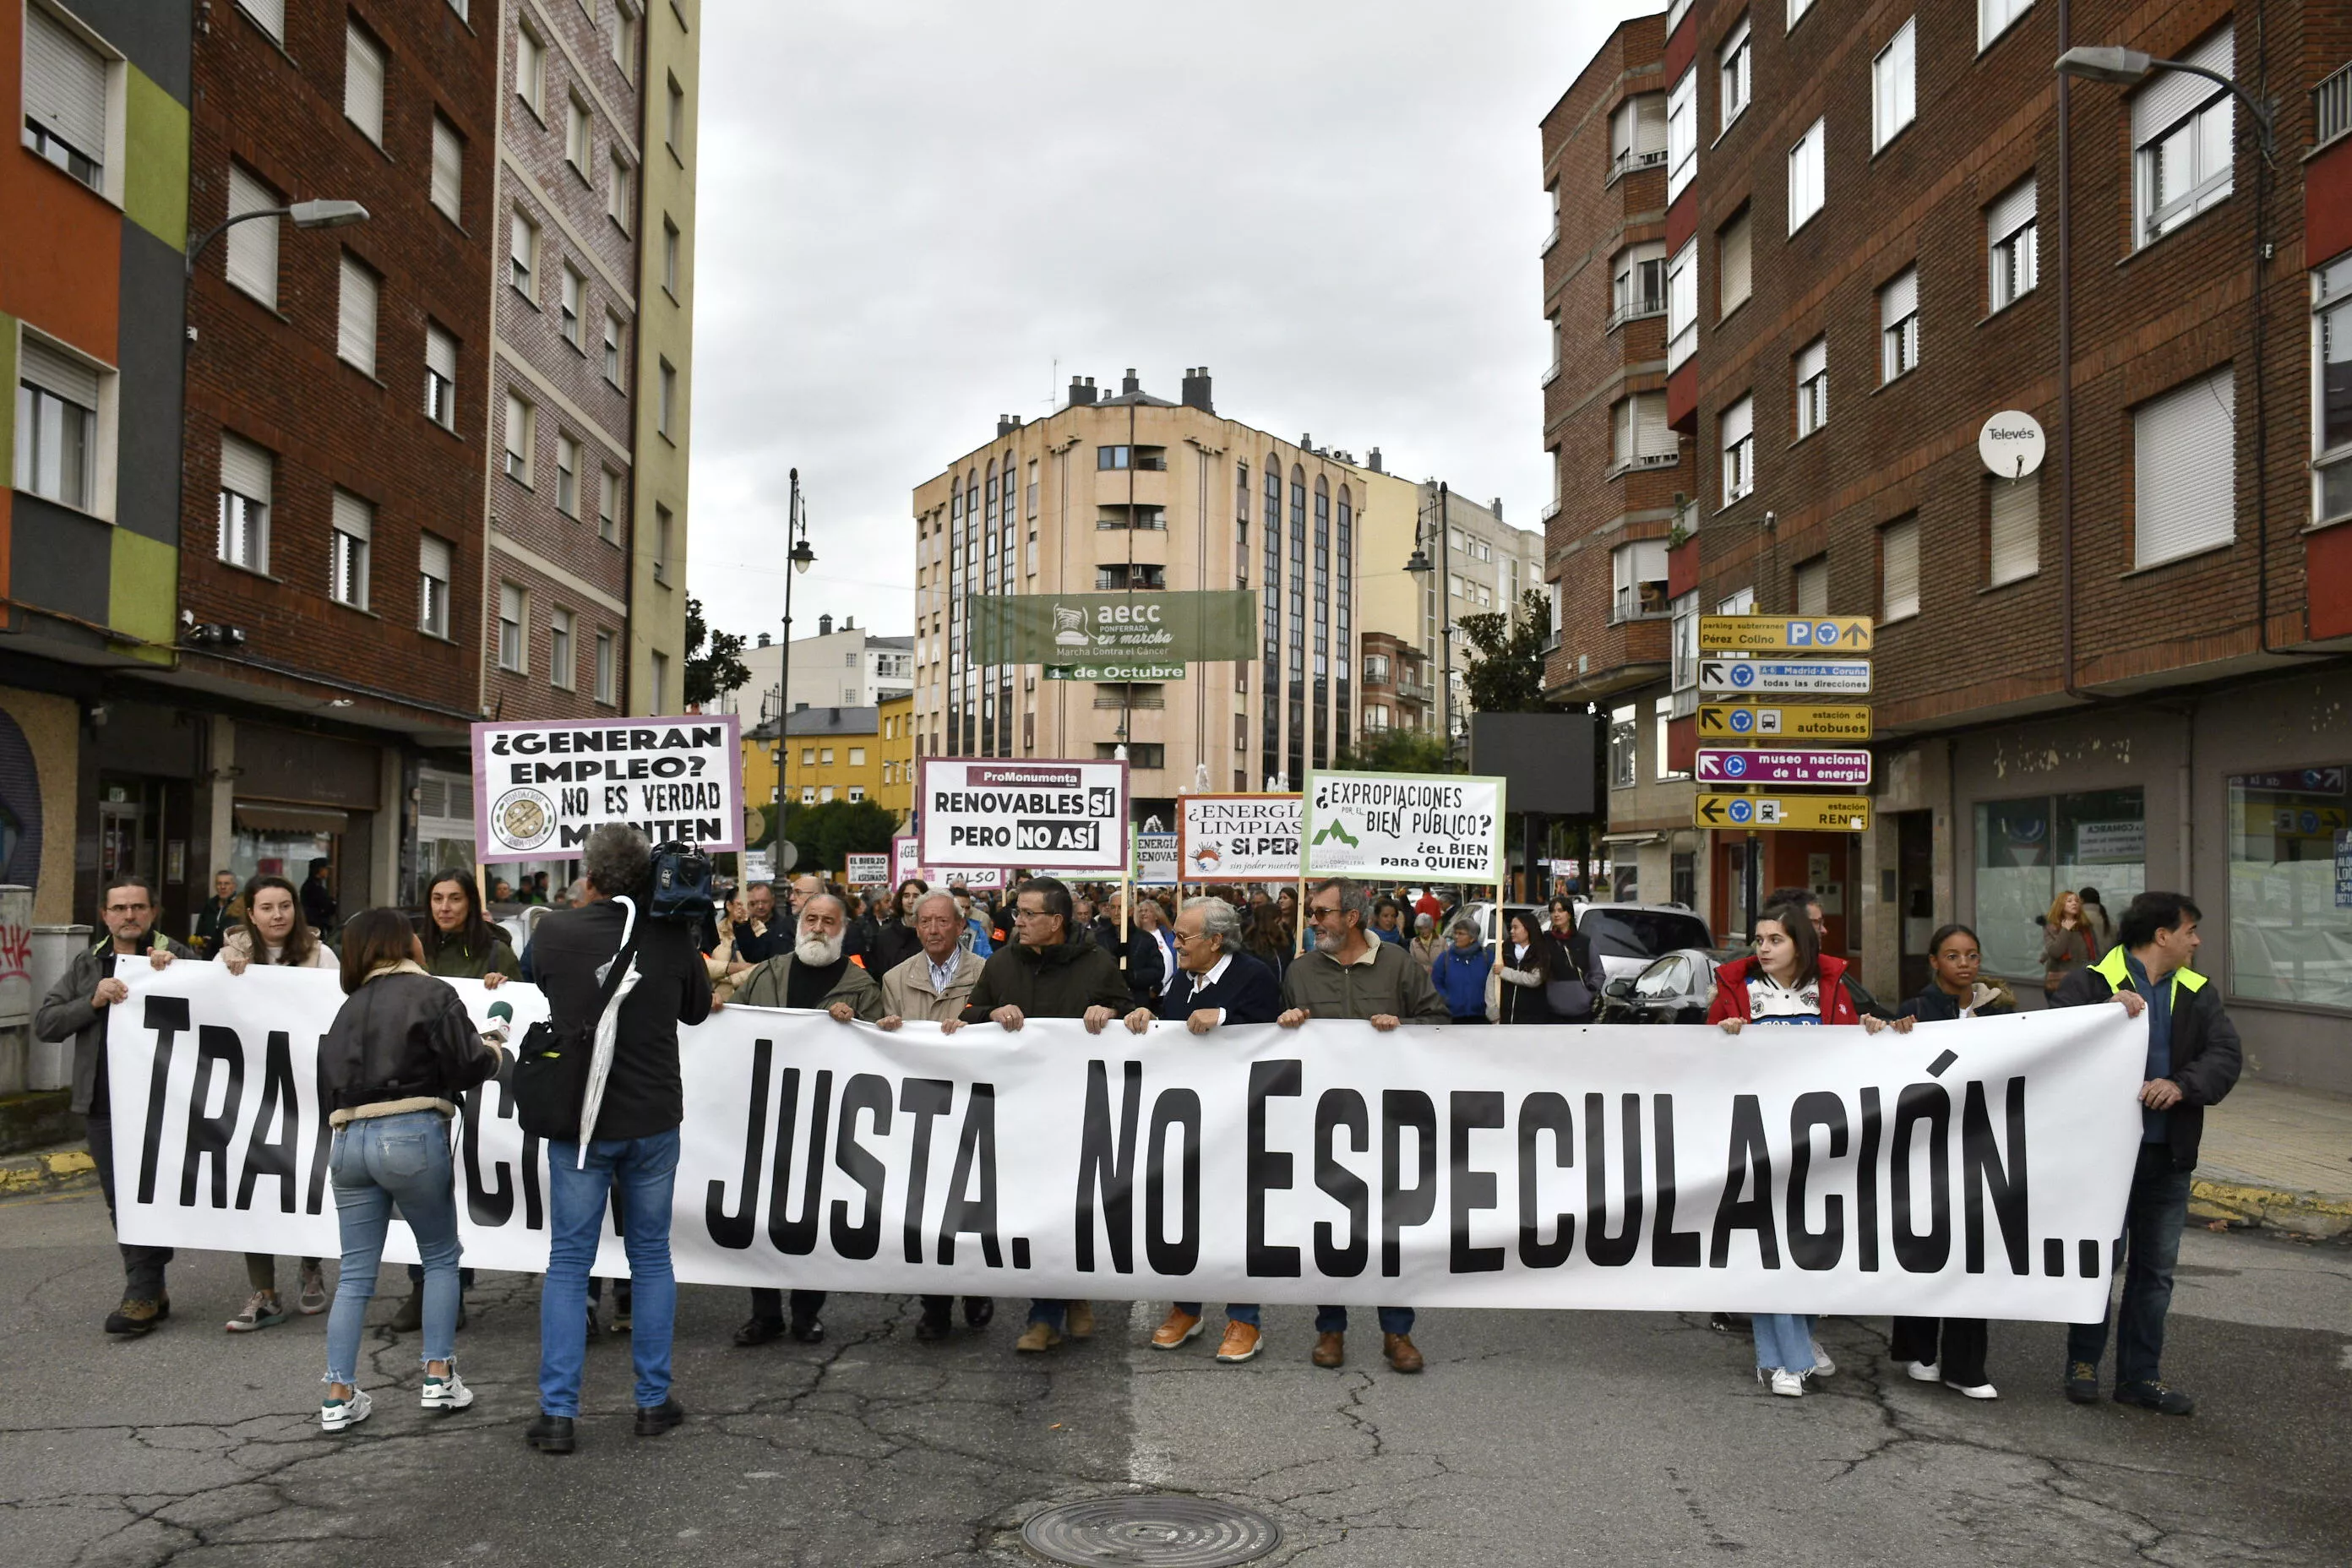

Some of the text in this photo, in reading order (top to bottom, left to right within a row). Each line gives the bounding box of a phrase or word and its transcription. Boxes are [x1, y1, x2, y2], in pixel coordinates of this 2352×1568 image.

[1989, 427, 2034, 439] Televés
[1097, 604, 1161, 623] aecc
[1097, 629, 1174, 645] en marcha
[1702, 634, 1775, 644] Pérez Colino
[1057, 645, 1169, 656] Marcha Contra el Cáncer
[1074, 666, 1097, 678] de
[1103, 666, 1184, 678] Octubre
[1794, 679, 1808, 688] las
[1814, 680, 1867, 689] direcciones
[1812, 710, 1850, 719] estación
[1798, 722, 1866, 733] autobuses
[491, 727, 721, 756] ¿GENERAN
[1758, 754, 1865, 765] museo nacional
[510, 756, 706, 784] EMPLEO?
[983, 771, 1078, 783] ProMonumenta
[1773, 767, 1865, 781] de la energía
[561, 781, 721, 818] NO ES VERDAD
[935, 789, 1113, 816] RENOVABLES SÍ
[1315, 782, 1462, 809] ¿EXPROPIACIONES
[1189, 802, 1304, 822] ¿ENERGÍ
[1827, 803, 1865, 811] estación
[1200, 821, 1303, 835] LIMPIAS
[1367, 807, 1407, 838] BIEN
[950, 823, 1096, 850] PERO NO ASÍ
[1257, 838, 1301, 855] PER
[1449, 843, 1488, 856] BIEN
[1230, 861, 1242, 869] sin
[1241, 860, 1266, 874] joder
[1425, 857, 1488, 871] QUIEN?
[946, 872, 995, 885] FALSO
[706, 1039, 1031, 1269] JUSTA.
[1075, 1059, 1201, 1276] NO
